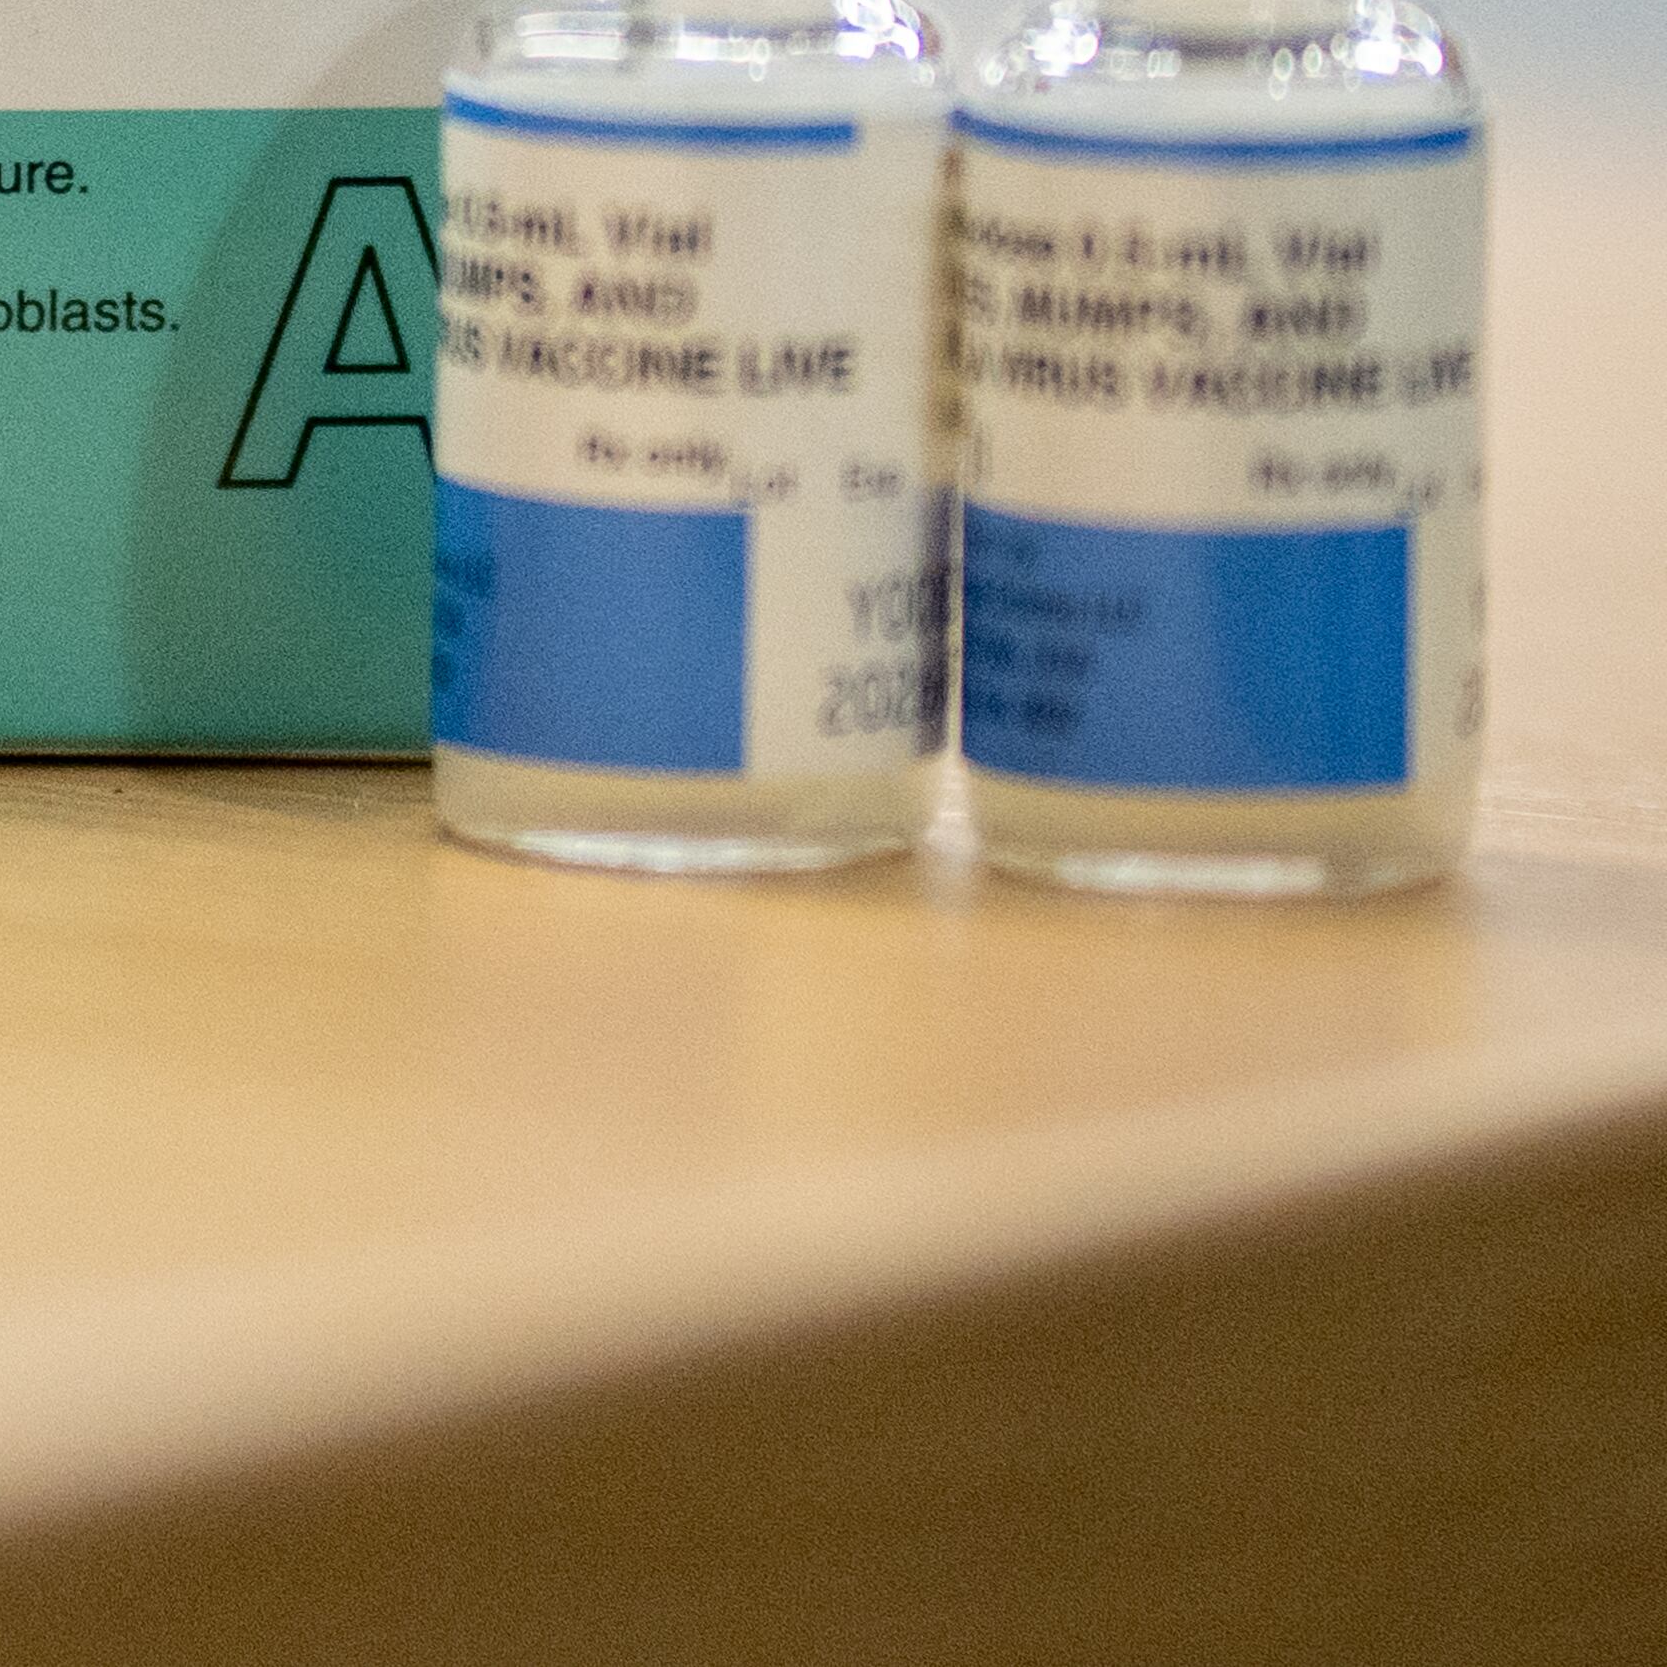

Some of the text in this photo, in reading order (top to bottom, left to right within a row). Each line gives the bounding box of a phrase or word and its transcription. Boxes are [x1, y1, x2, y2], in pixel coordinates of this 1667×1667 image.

[214, 175, 439, 489] A
[499, 328, 727, 392] VACCINE
[737, 338, 857, 396] LIVE
[1147, 358, 1385, 412] VACCINE
